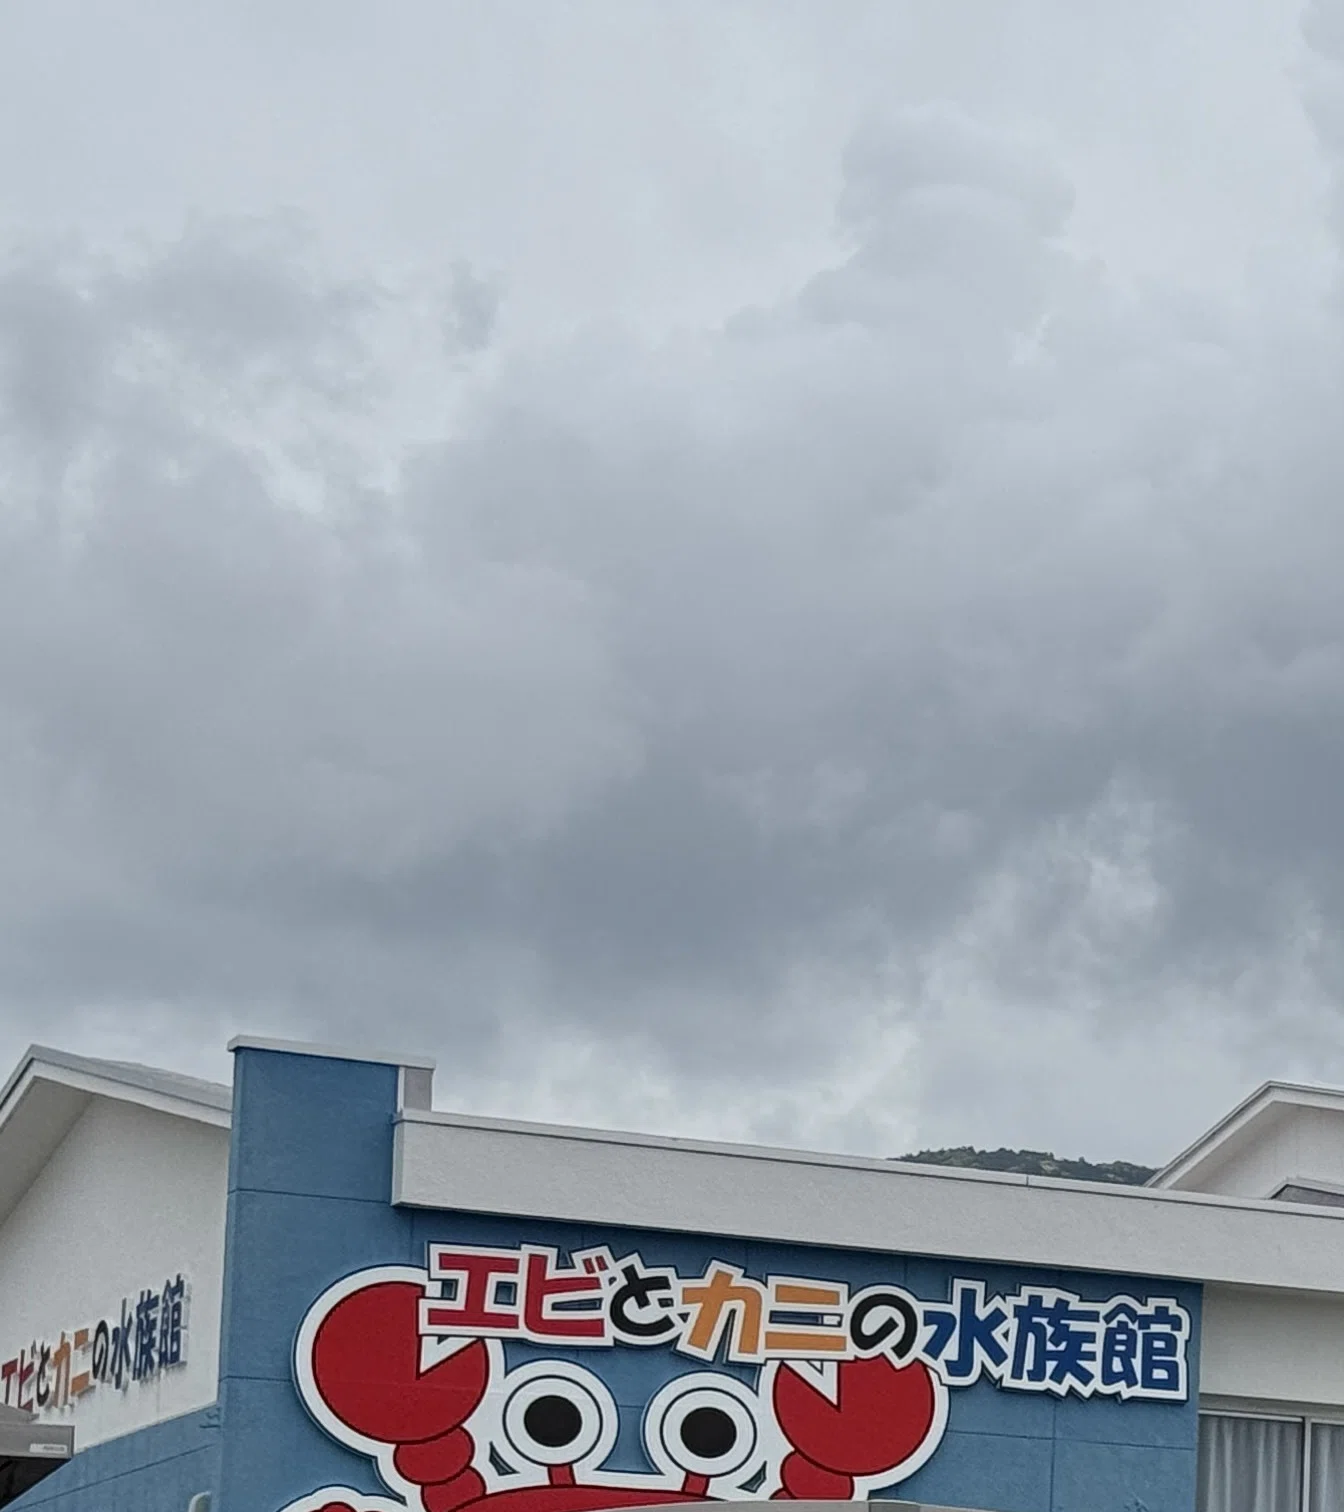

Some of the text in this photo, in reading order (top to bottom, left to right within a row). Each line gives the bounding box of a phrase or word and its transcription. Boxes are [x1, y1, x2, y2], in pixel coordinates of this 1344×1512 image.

[1, 1273, 185, 1413] エビとカニの水族館
[422, 1249, 1186, 1395] エビとカニの水族館
